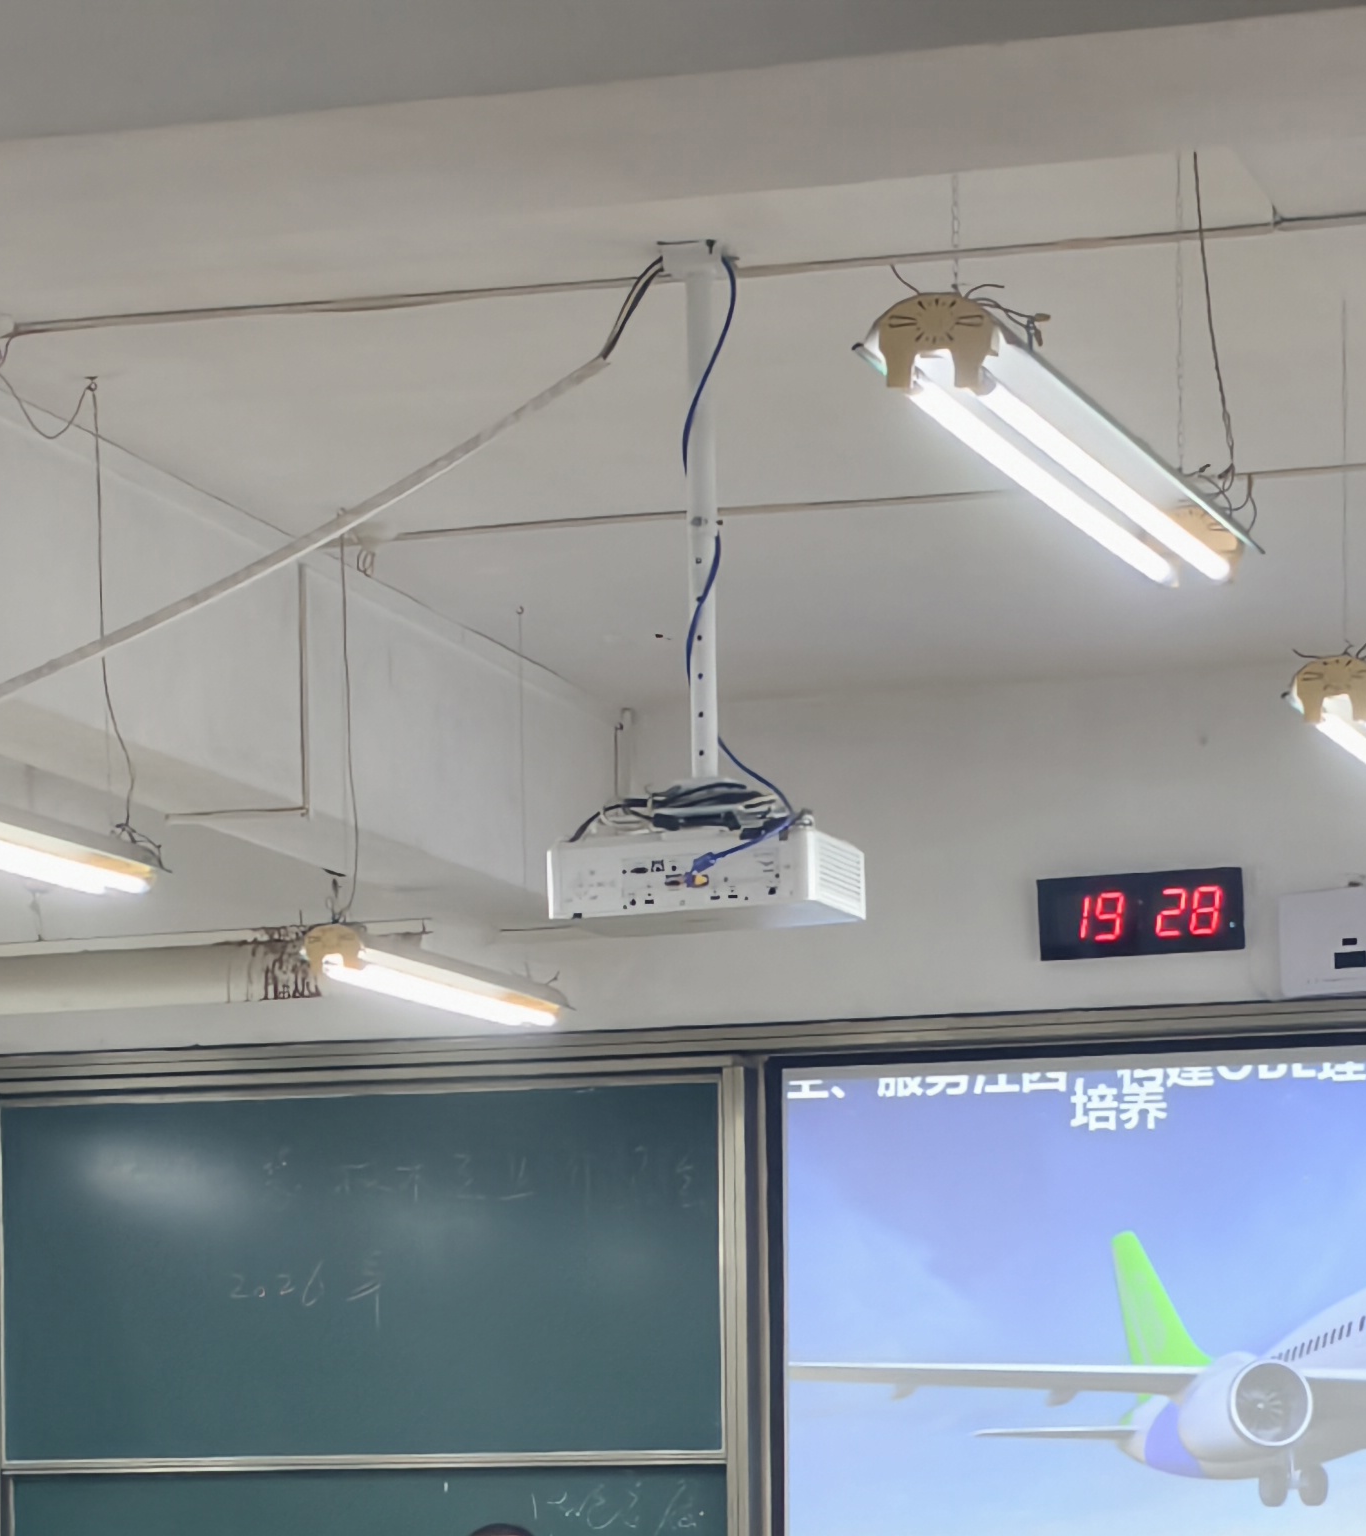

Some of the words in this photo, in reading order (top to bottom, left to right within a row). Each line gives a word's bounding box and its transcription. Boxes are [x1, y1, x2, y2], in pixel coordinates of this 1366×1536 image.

[1078, 891, 1126, 942] 19
[1154, 885, 1224, 938] 28
[1070, 1077, 1168, 1132] 培养
